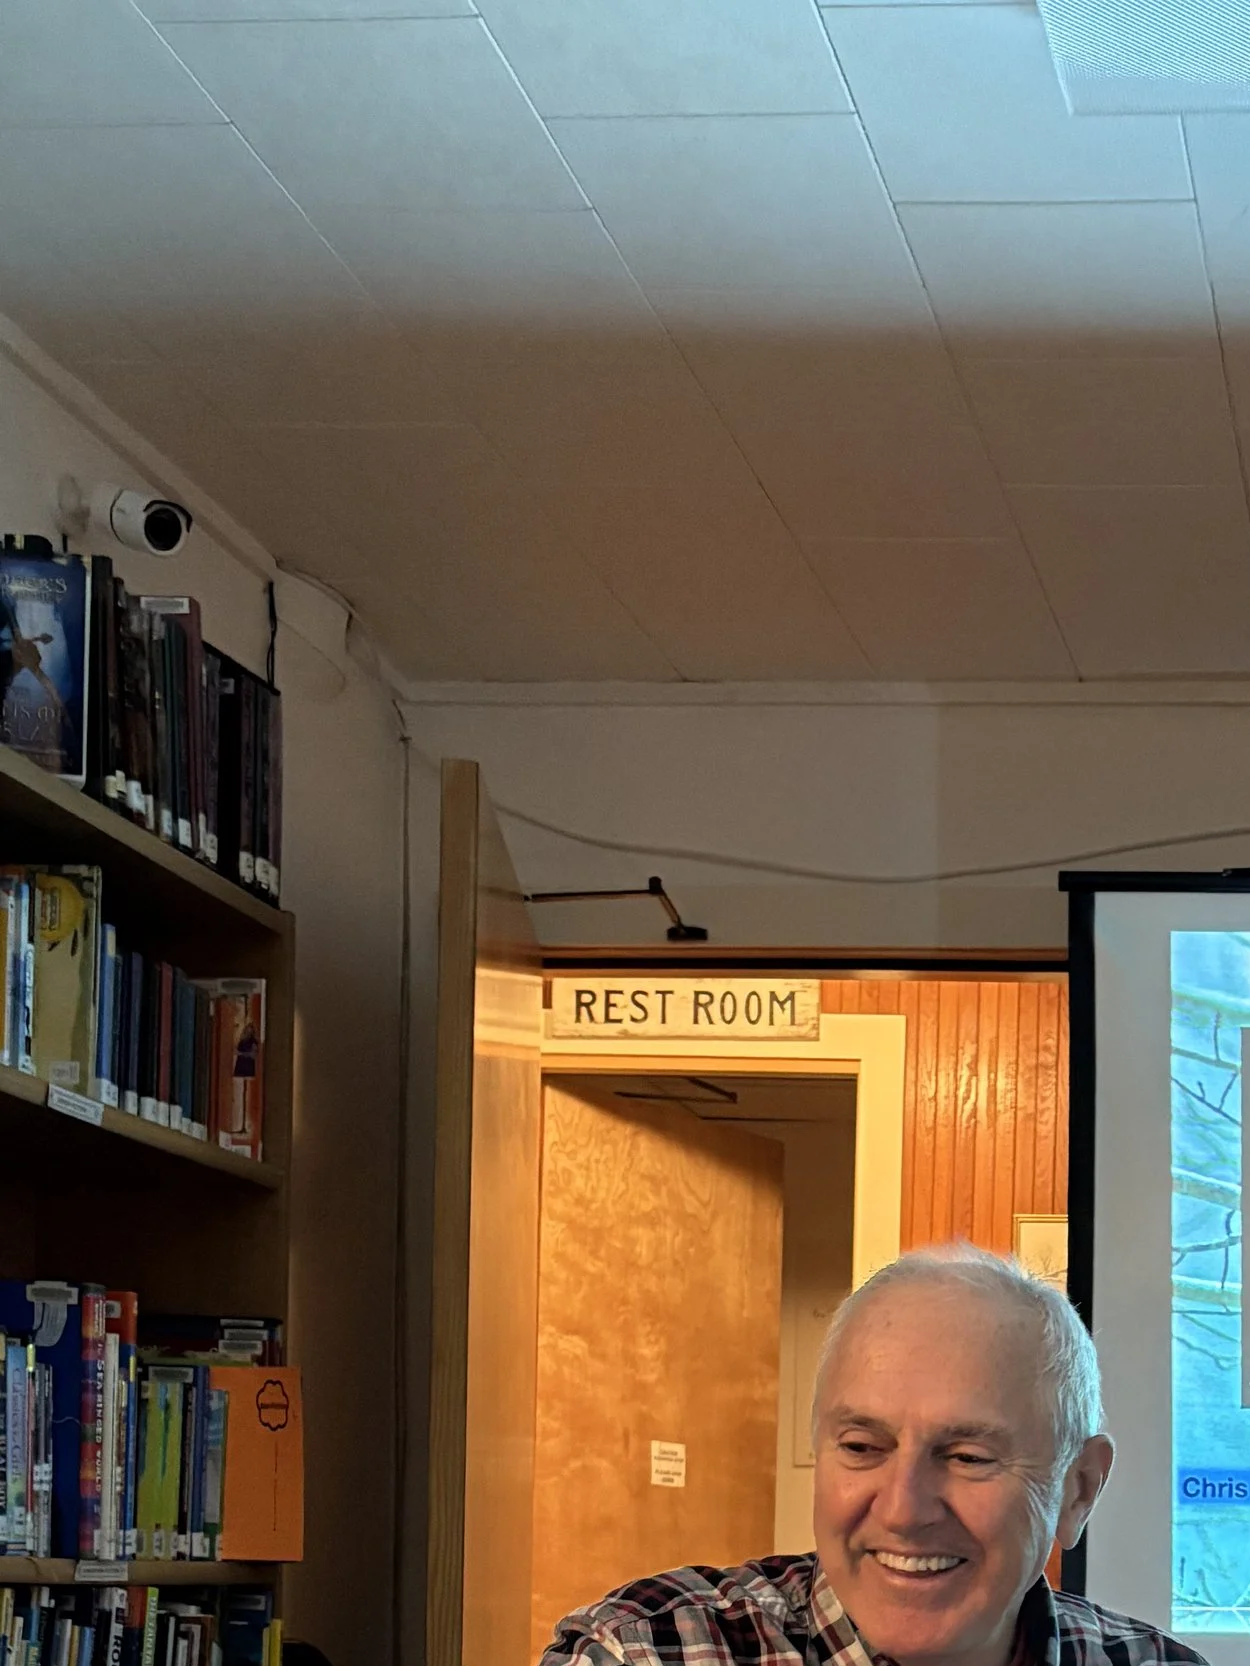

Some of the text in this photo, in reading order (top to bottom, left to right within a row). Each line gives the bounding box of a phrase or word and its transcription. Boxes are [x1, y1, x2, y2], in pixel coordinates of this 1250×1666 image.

[574, 989, 796, 1026] REST ROOM
[1182, 1477, 1248, 1499] Chris
